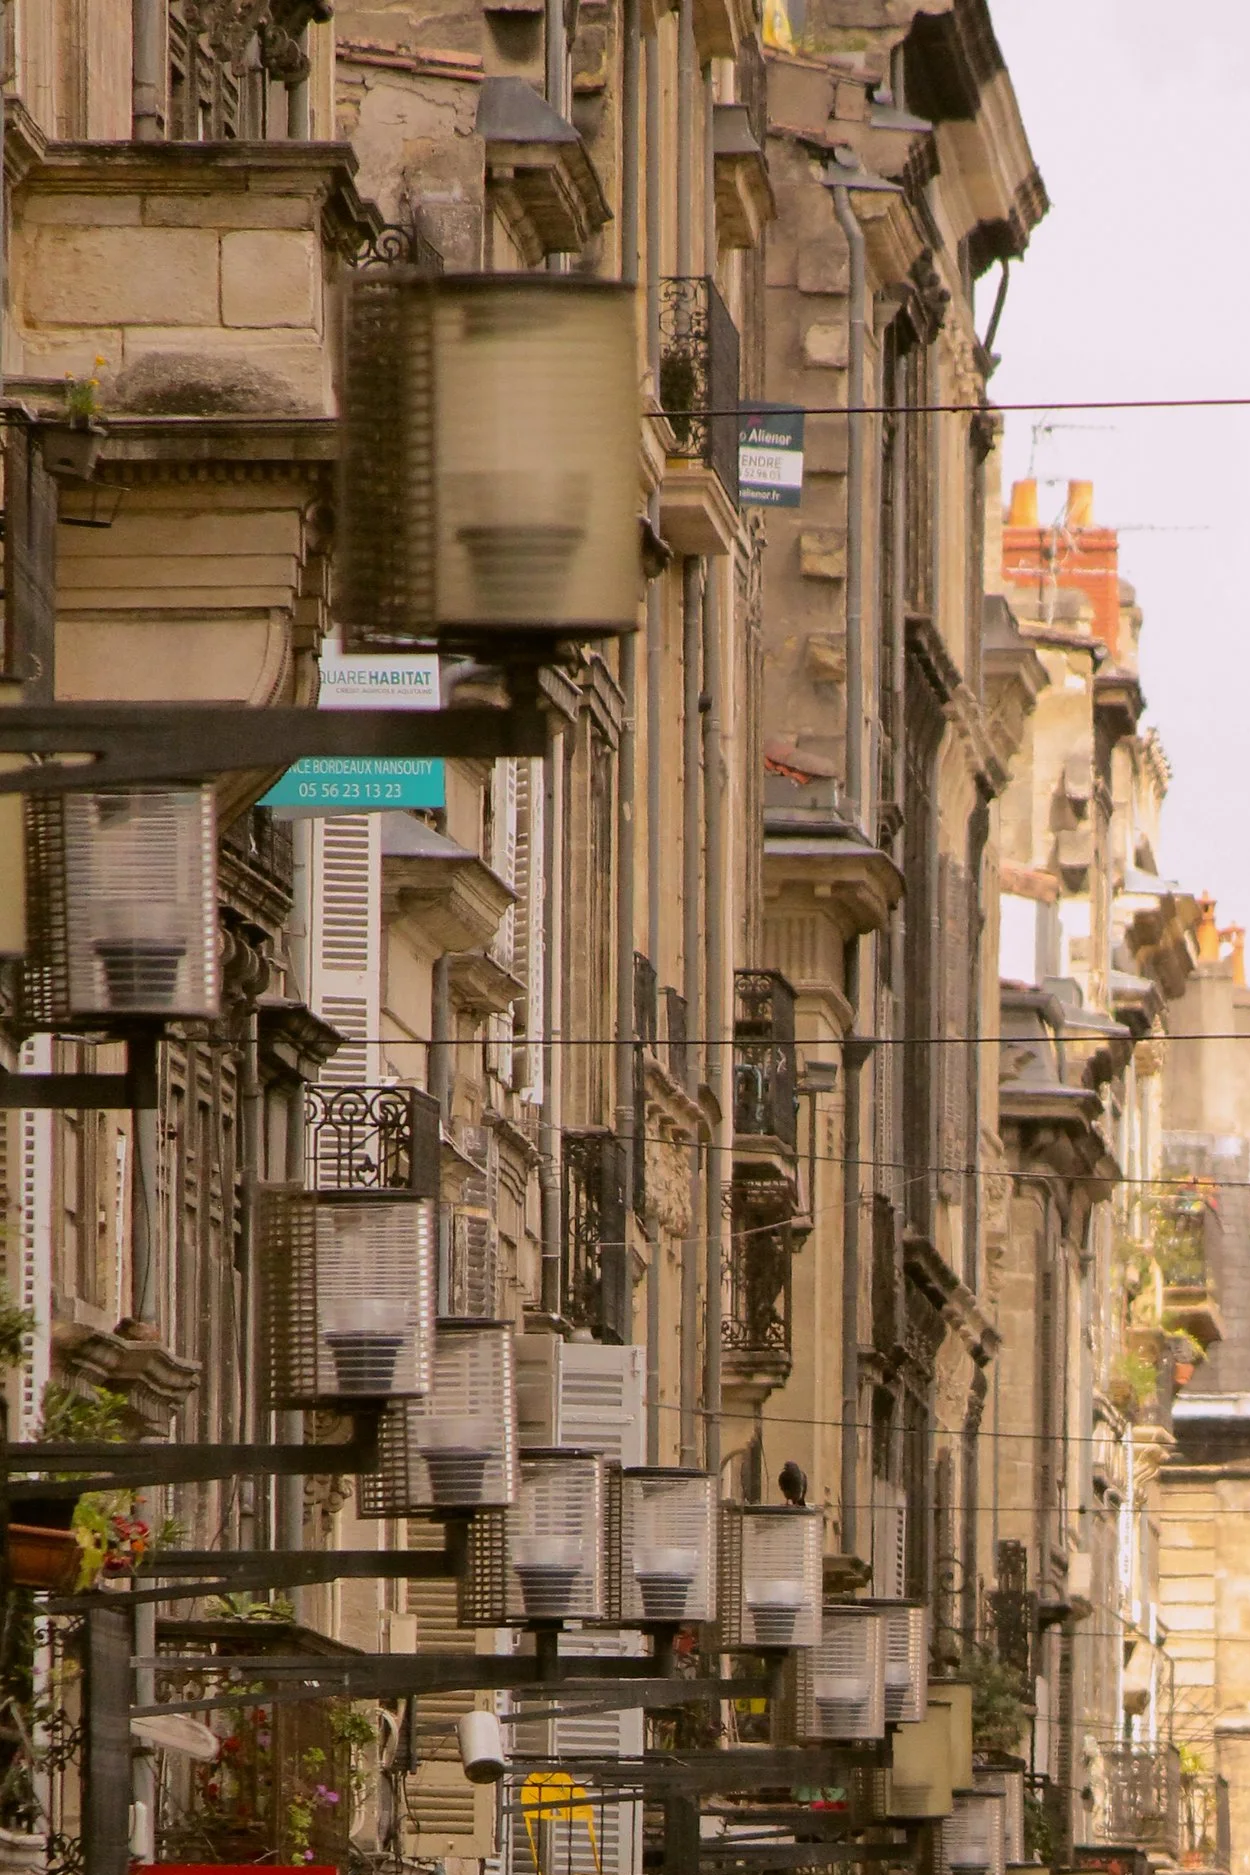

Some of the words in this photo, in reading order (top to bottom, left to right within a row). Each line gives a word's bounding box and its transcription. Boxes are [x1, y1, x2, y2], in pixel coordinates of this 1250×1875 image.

[748, 428, 792, 446] Alienor
[740, 453, 782, 470] ENDRE
[739, 487, 781, 501] alienor.fr
[313, 759, 371, 775] BORDEAUX
[373, 759, 433, 776] NANSOUTY
[299, 782, 317, 797] 05
[321, 782, 339, 797] 56
[343, 783, 360, 798] 23
[365, 783, 381, 798] 13
[385, 783, 401, 798] 23
